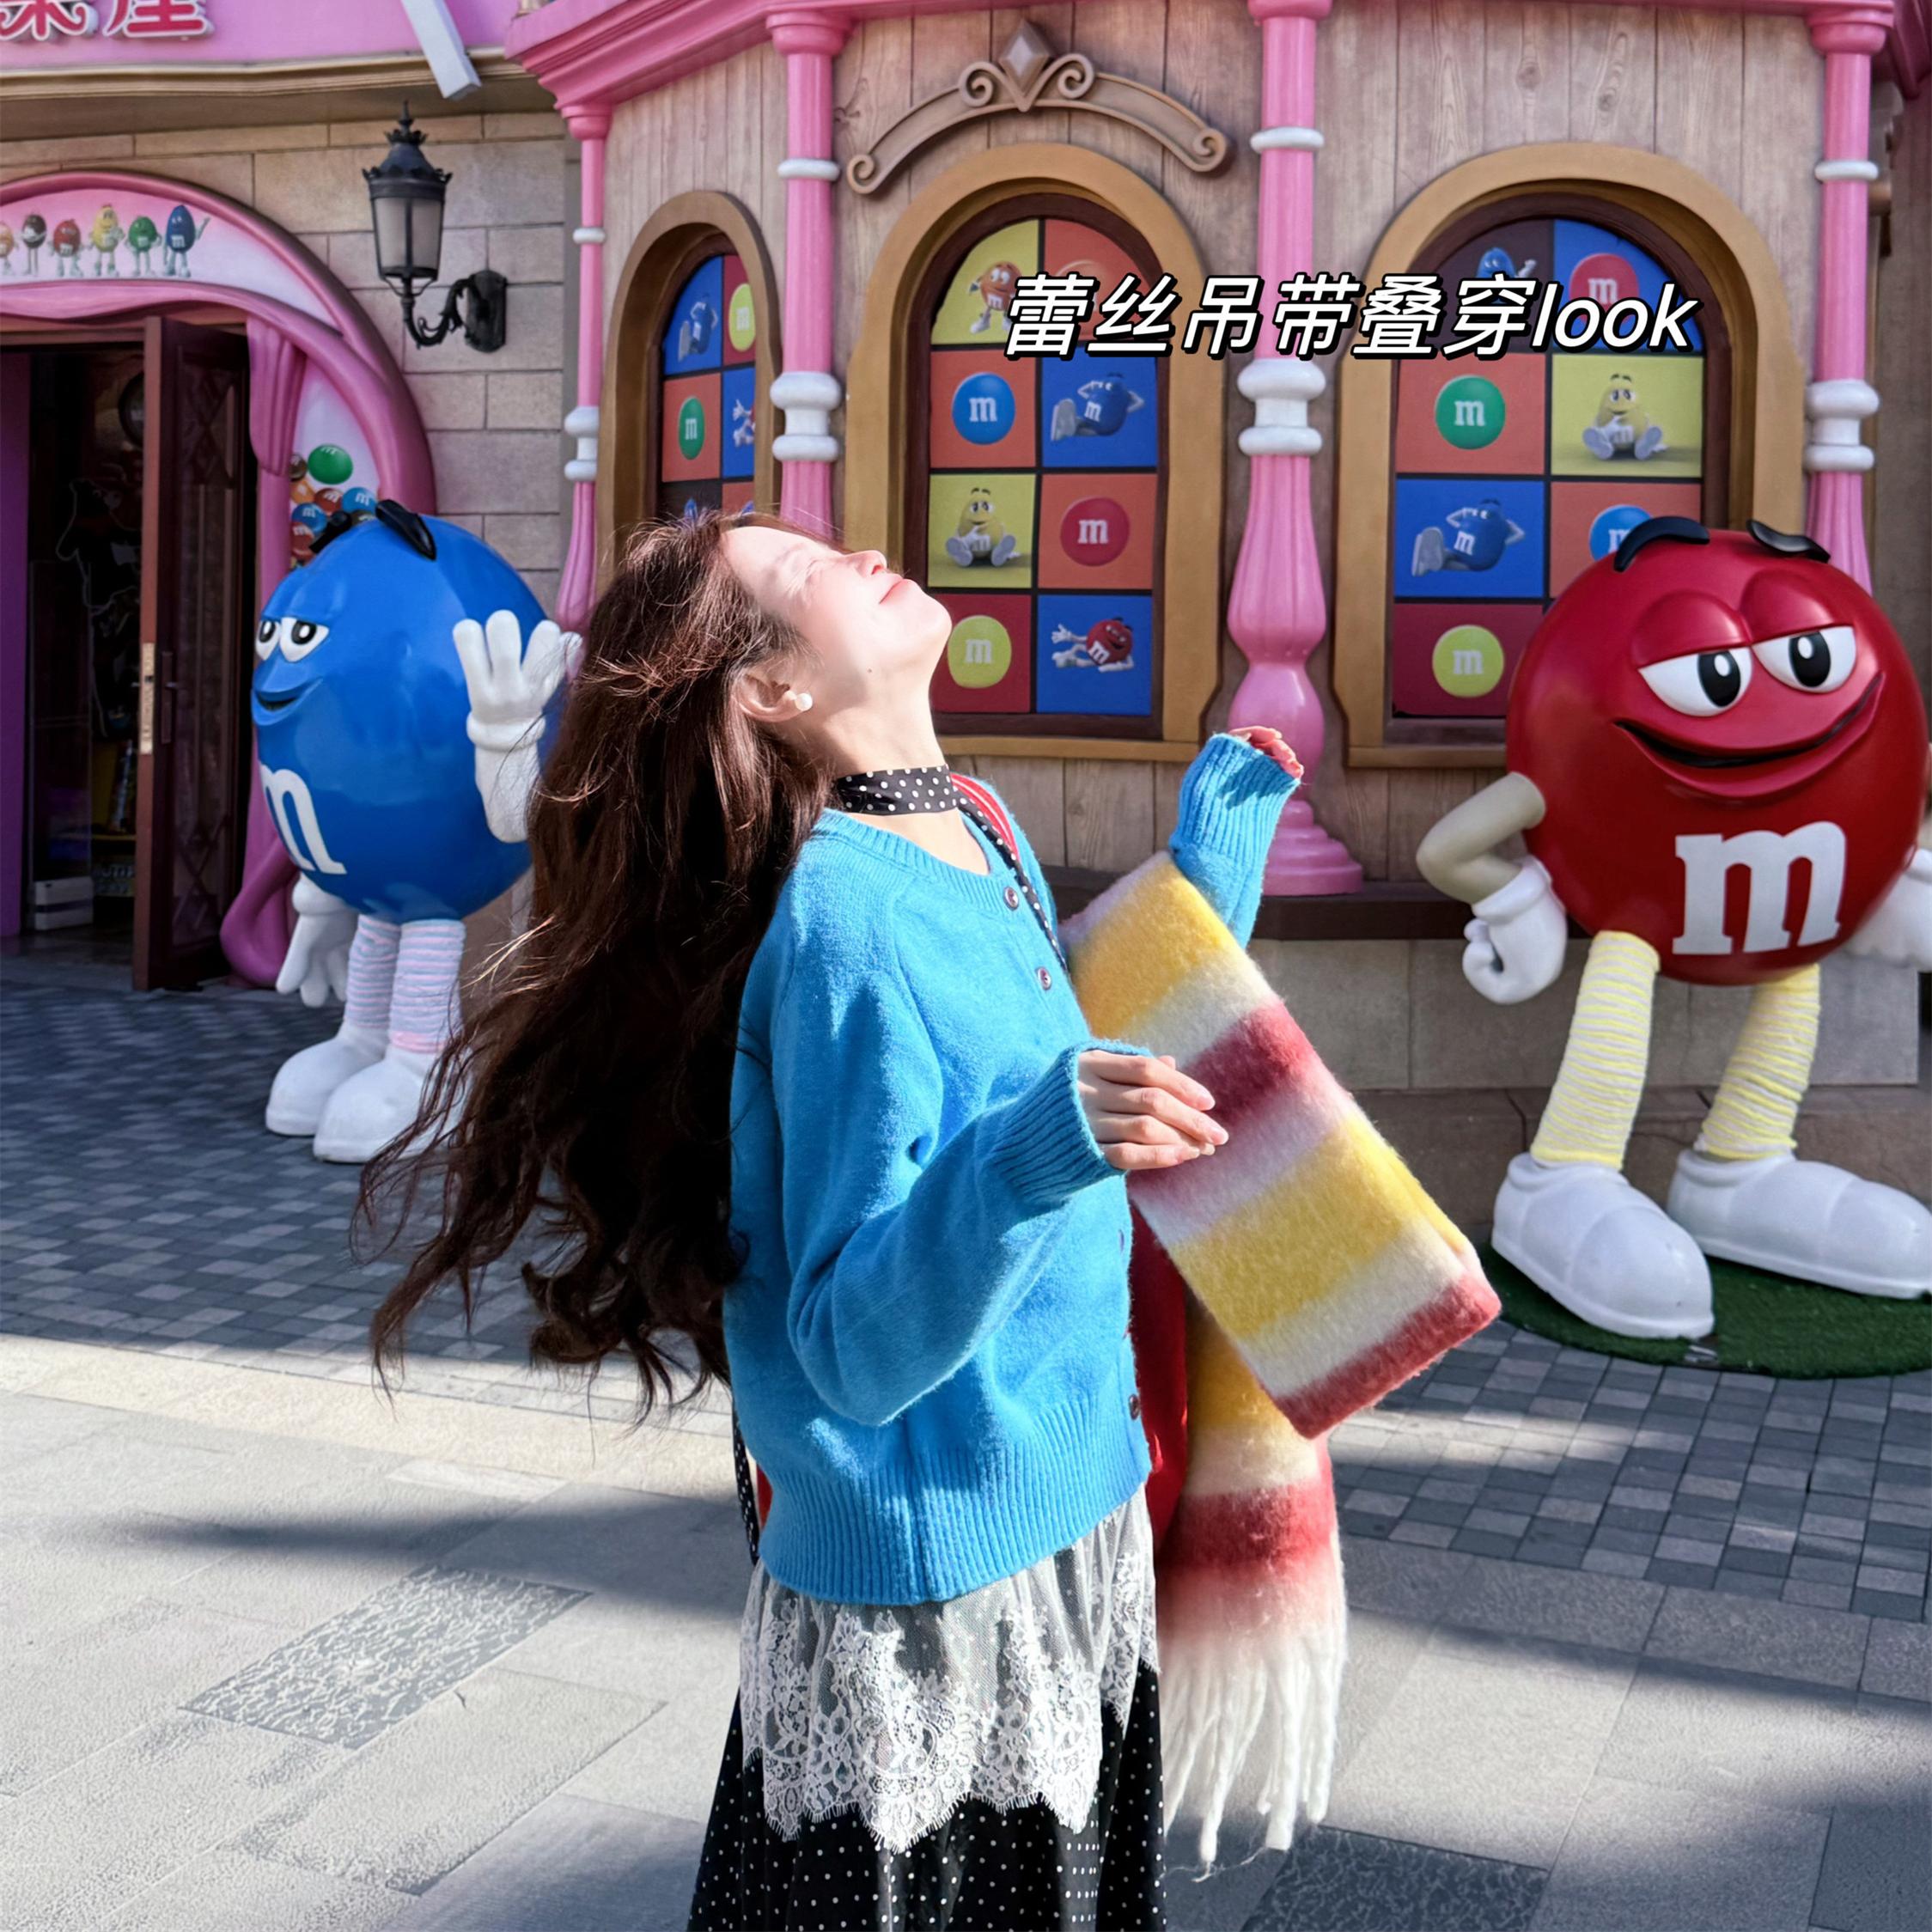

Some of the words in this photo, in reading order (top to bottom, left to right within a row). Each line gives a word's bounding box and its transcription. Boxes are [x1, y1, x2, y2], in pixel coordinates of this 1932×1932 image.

[1588, 278, 1618, 305] m
[969, 398, 997, 422] m
[1084, 400, 1101, 421] m
[1454, 400, 1485, 426] m
[1078, 519, 1108, 544] m
[1454, 530, 1476, 556] m
[965, 638, 993, 664] m
[1088, 641, 1110, 664] m
[1453, 649, 1484, 674] m
[1673, 820, 1846, 955] m
